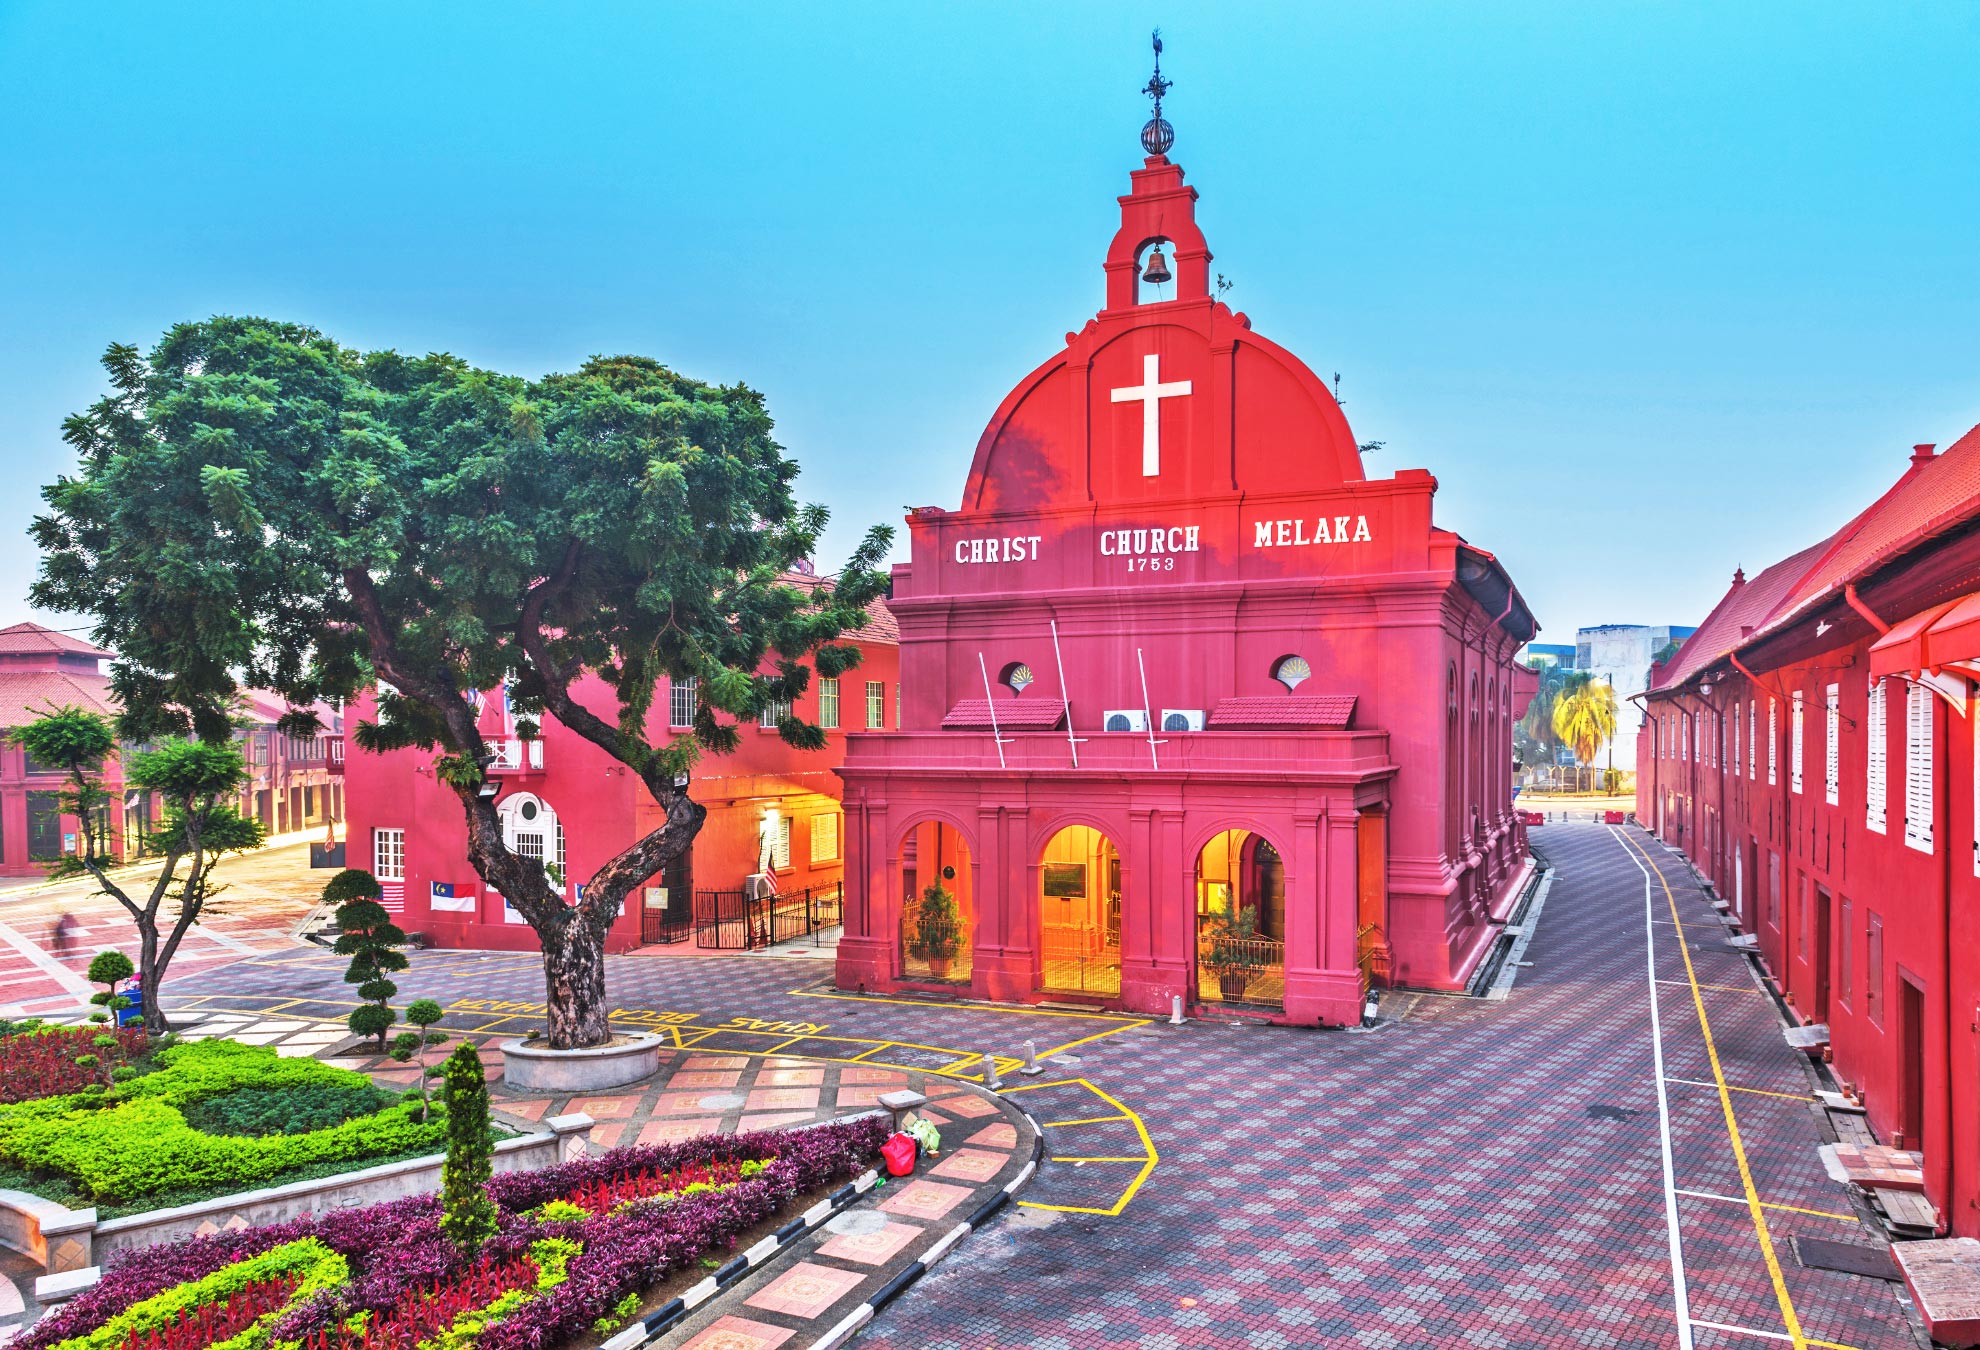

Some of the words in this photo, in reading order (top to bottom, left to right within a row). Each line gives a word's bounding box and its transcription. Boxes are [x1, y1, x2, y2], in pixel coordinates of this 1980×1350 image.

[955, 536, 1042, 564] CHRIST
[1100, 525, 1200, 556] CHURCH
[1253, 515, 1372, 548] MELAKA
[1127, 557, 1174, 572] 1753
[607, 1008, 700, 1024] BECA
[718, 1017, 829, 1034] KHAS
